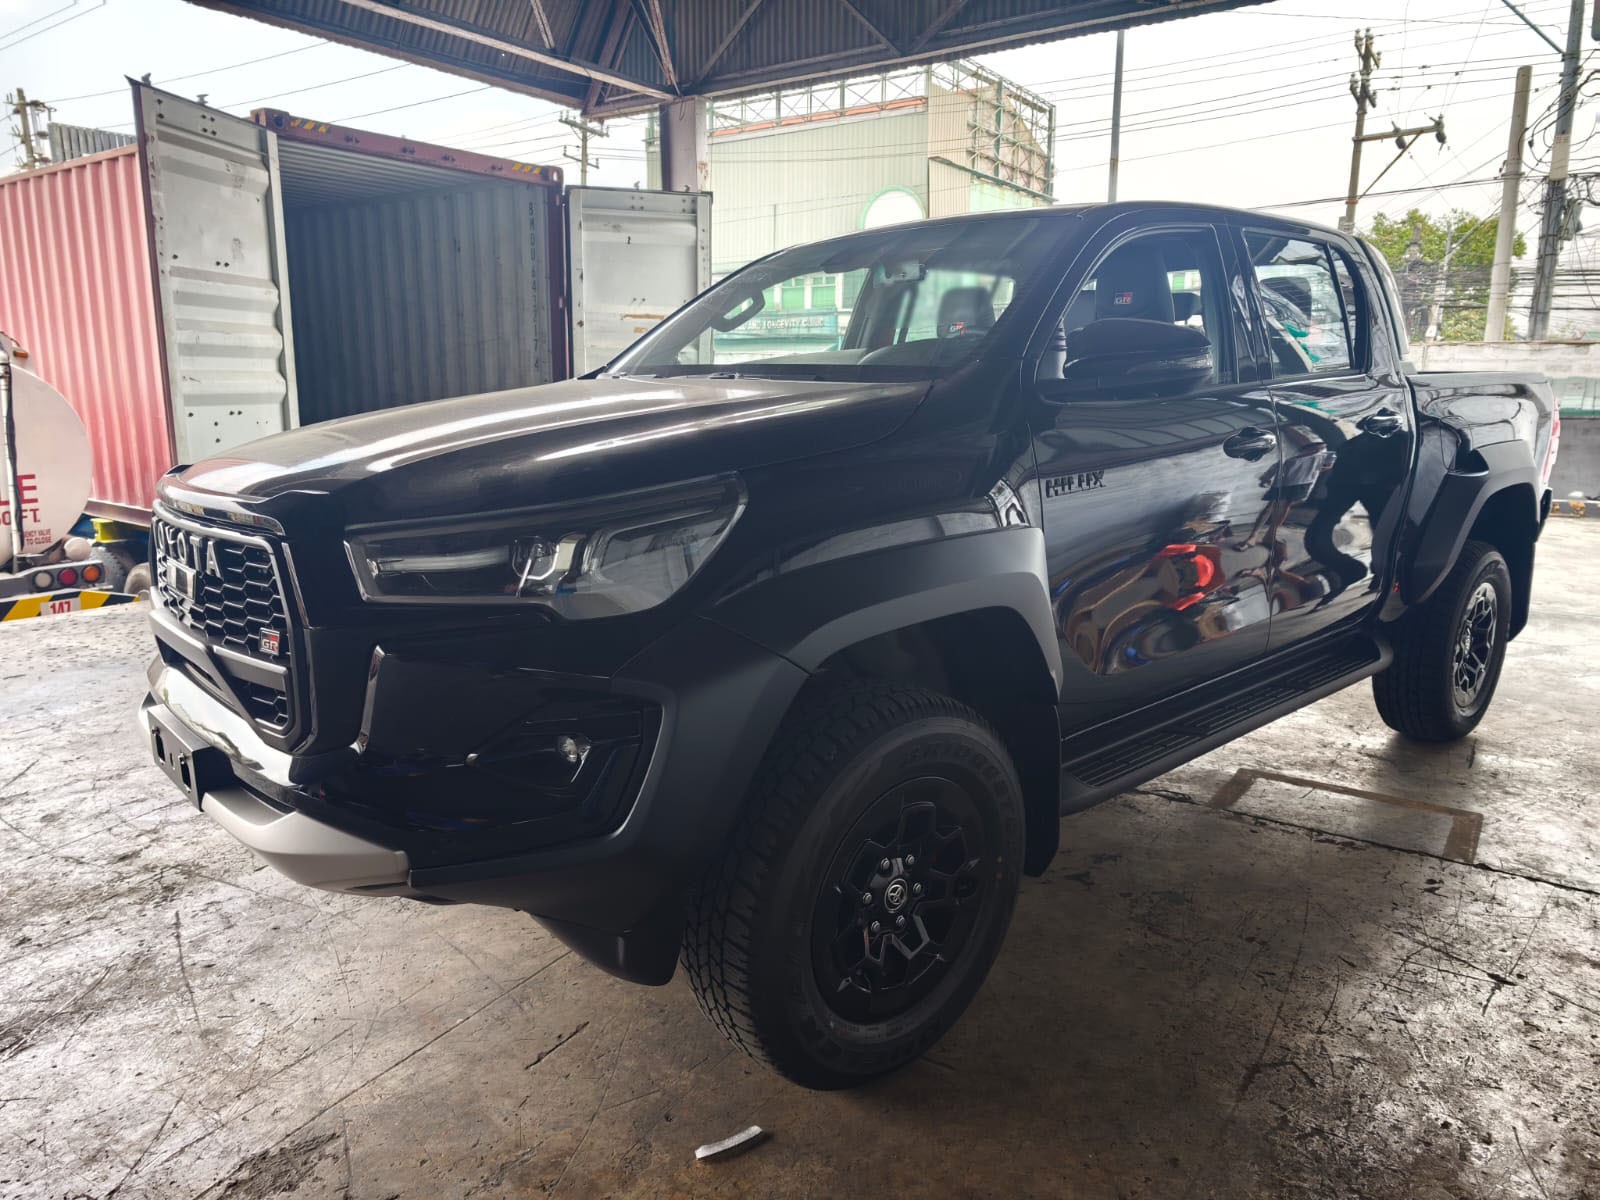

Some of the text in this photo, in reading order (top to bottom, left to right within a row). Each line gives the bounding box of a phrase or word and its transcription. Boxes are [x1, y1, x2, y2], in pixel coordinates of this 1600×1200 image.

[802, 318, 824, 329] CLINIC
[35, 536, 52, 545] CLOSE
[50, 600, 71, 614] 147
